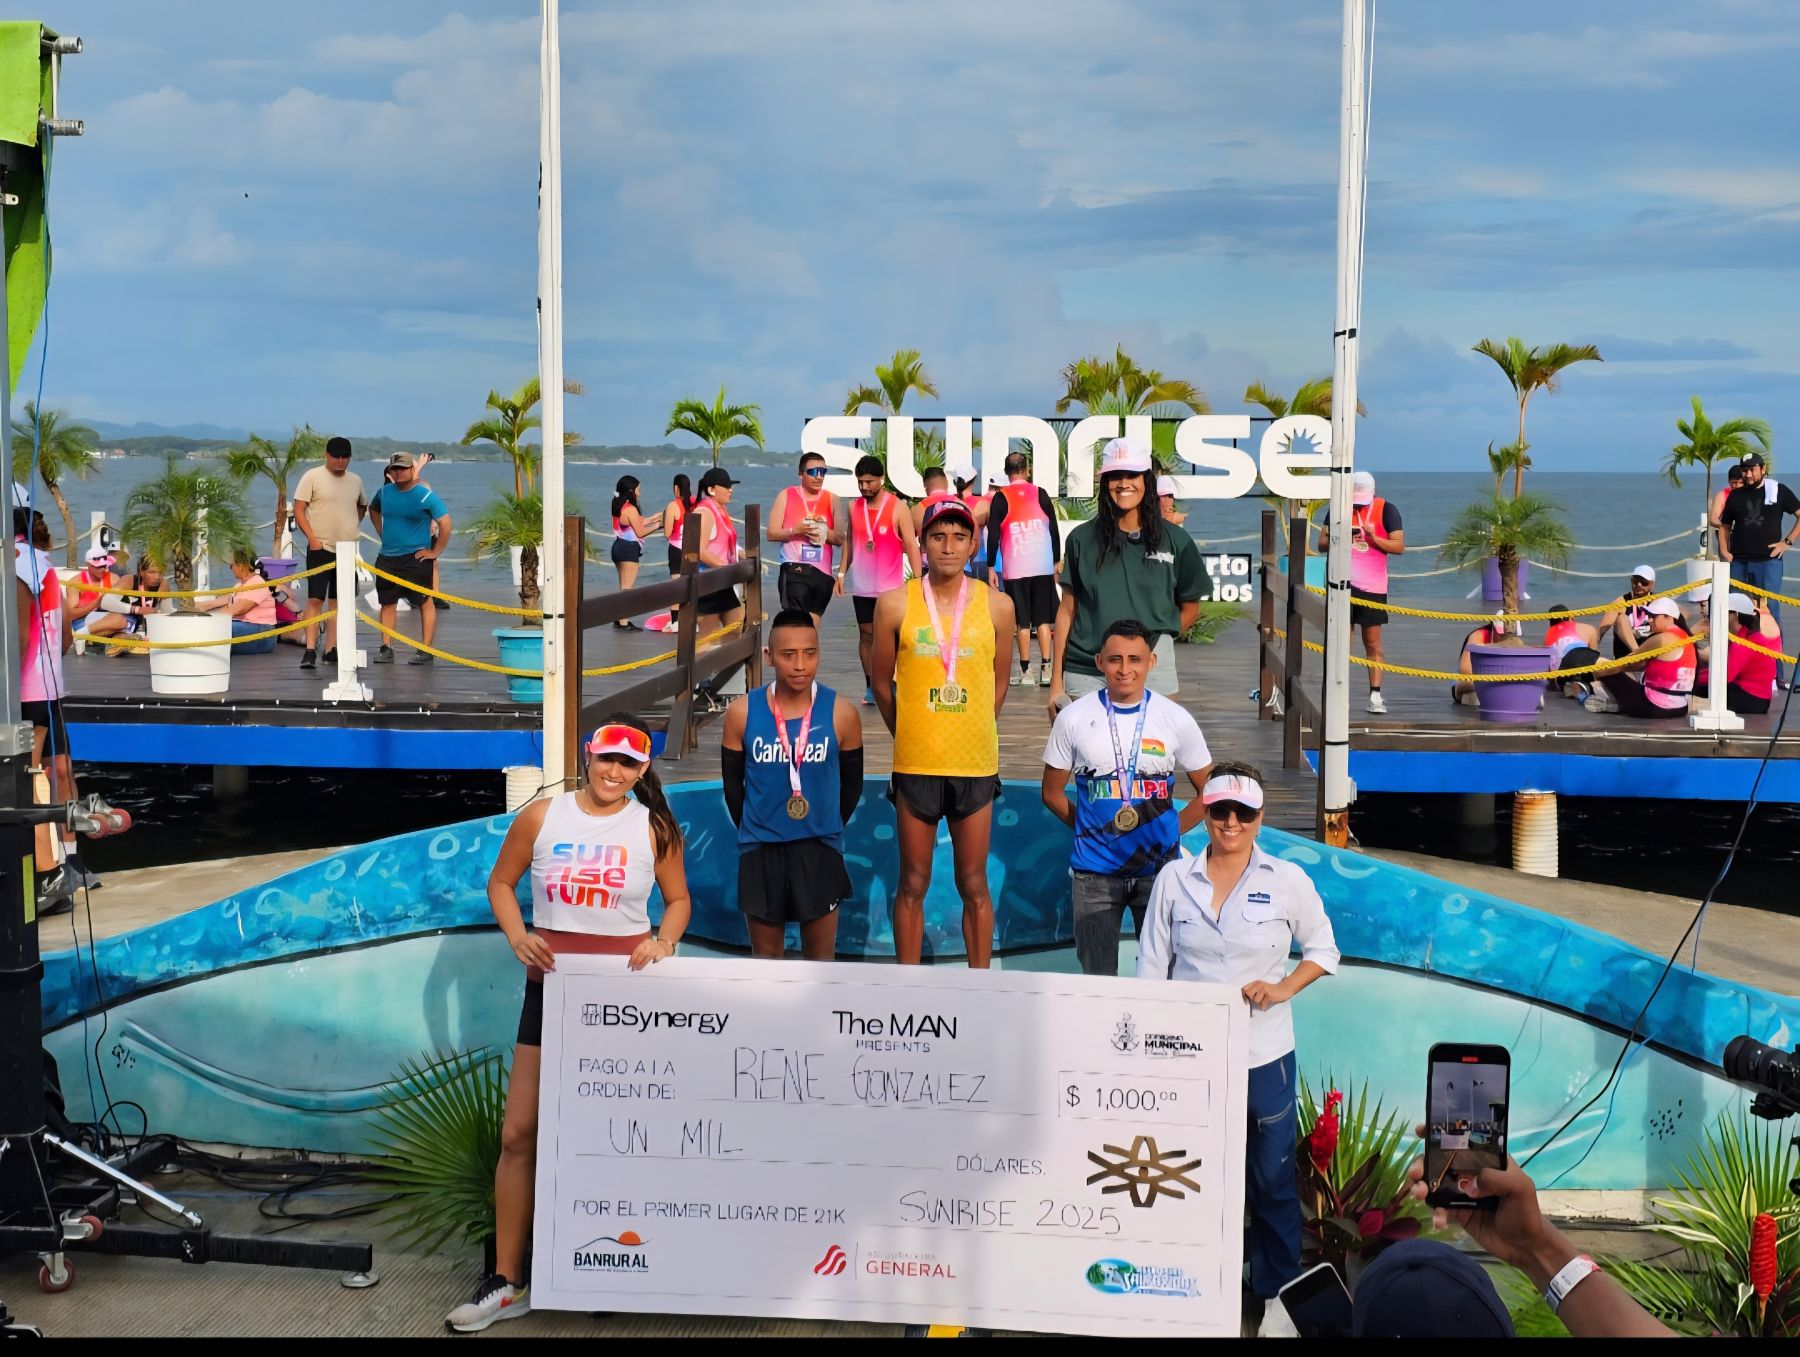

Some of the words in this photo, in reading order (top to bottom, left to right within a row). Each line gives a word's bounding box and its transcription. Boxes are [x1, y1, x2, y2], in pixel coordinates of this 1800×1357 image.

[1206, 554, 1249, 576] rto
[1201, 577, 1253, 603] ios
[551, 843, 628, 867] sun
[545, 865, 626, 889] rise
[602, 1004, 729, 1035] BSynergy
[832, 1010, 884, 1036] The
[890, 1013, 957, 1039] MAN
[1144, 1040, 1203, 1052] MUNICIPAL
[633, 1059, 646, 1074] A
[733, 1047, 825, 1102] RENE
[578, 1081, 642, 1099] ORDEN
[647, 1083, 676, 1100] DE:
[609, 1117, 648, 1155] UN
[681, 1117, 744, 1158] MIL
[573, 1199, 611, 1216] POR
[617, 1200, 638, 1216] EL
[644, 1201, 712, 1220] PRIMER
[718, 1204, 779, 1222] LUGAR
[784, 1206, 808, 1223] DE
[814, 1207, 846, 1225] 21K
[900, 1190, 1017, 1227] SUNRISE
[1036, 1199, 1121, 1235] 2025
[574, 1251, 649, 1269] BANRURAL
[866, 1259, 957, 1279] GENERAL
